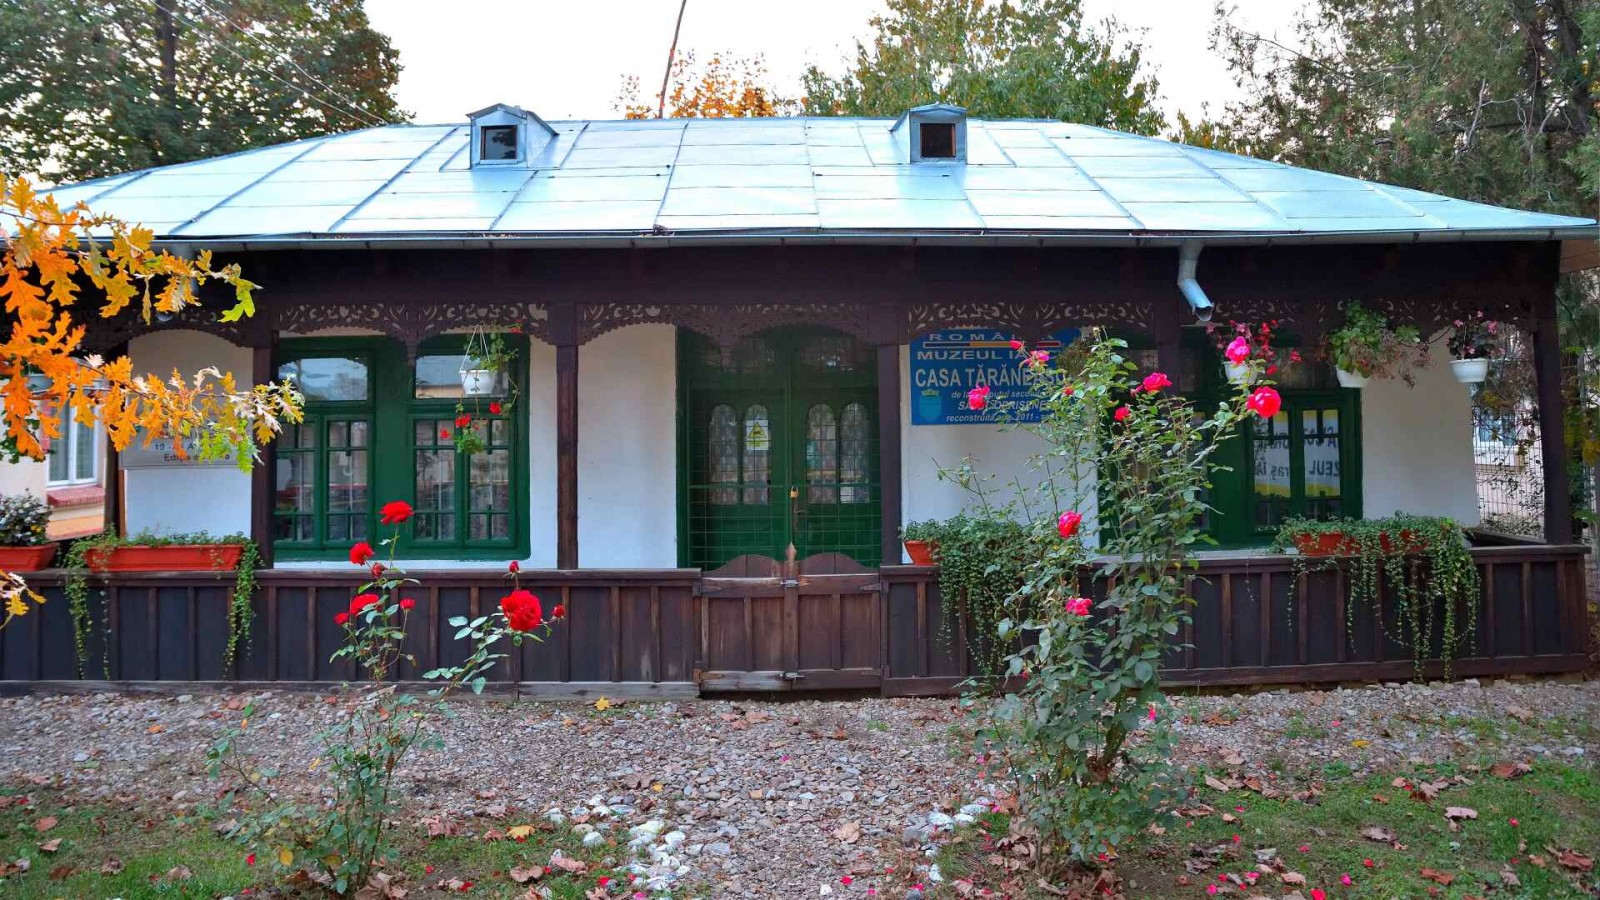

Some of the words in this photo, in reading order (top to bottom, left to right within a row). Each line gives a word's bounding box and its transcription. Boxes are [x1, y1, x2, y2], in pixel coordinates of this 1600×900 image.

[930, 331, 1054, 341] ROMÂA
[917, 350, 1003, 360] MUZEUL
[916, 368, 962, 387] CASA
[964, 363, 1065, 387] TĂRĂNEASC
[951, 389, 961, 399] de
[1016, 413, 1034, 421] 2011
